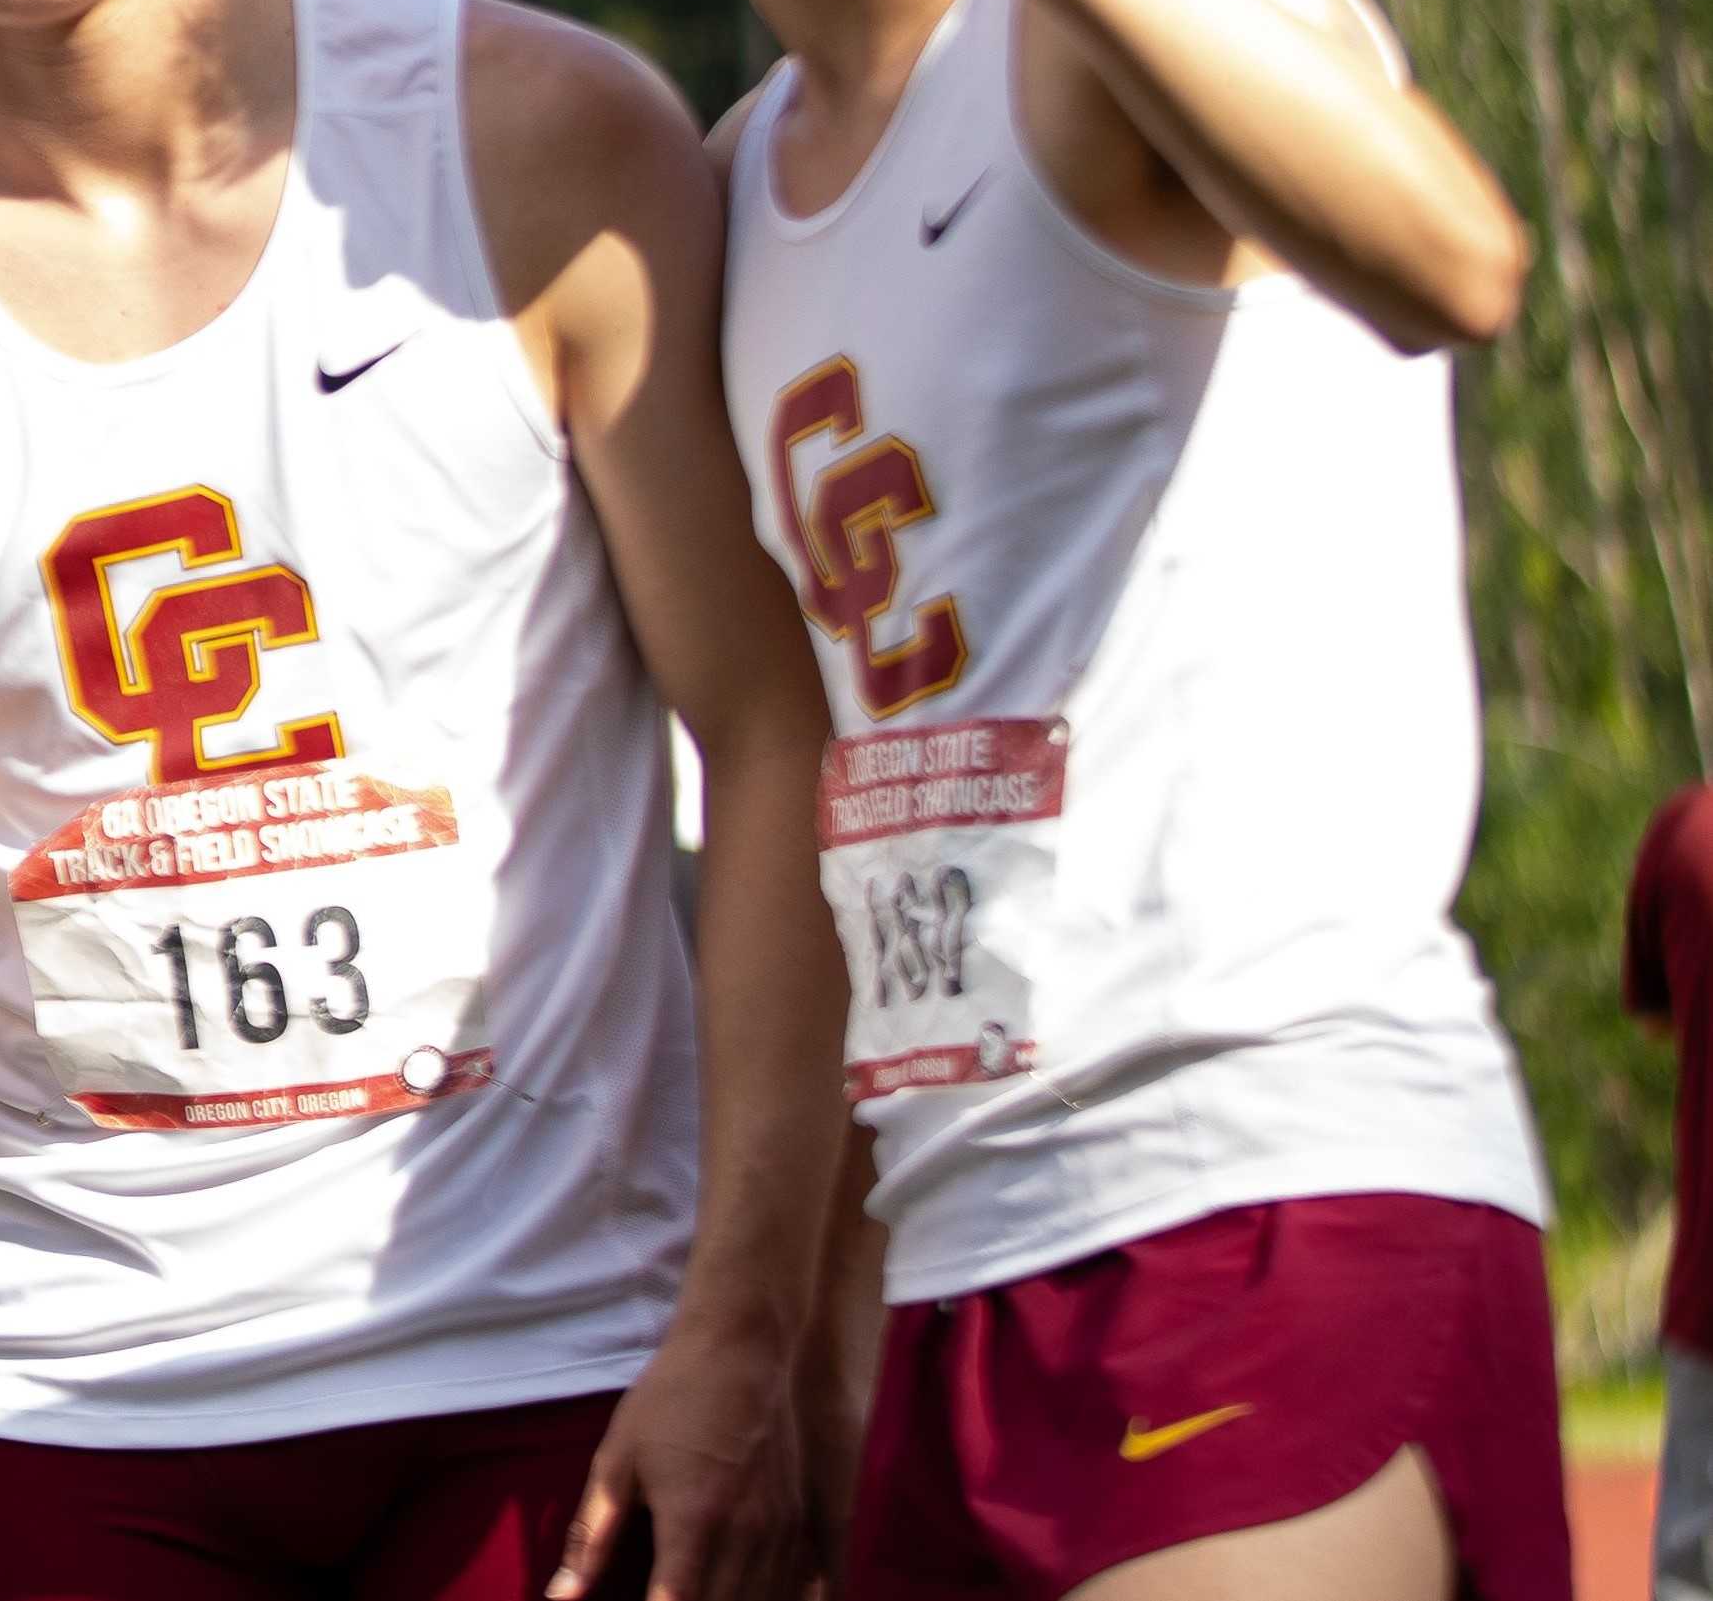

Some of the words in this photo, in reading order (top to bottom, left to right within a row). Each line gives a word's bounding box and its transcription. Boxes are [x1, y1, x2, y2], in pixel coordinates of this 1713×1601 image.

[39, 484, 345, 786] CC
[924, 729, 992, 772] STATE
[145, 783, 261, 835] OREGON
[263, 771, 358, 818] STATE
[48, 843, 147, 885] TRACK
[149, 841, 173, 877] &
[176, 828, 259, 875] FIELD
[150, 905, 371, 1051] 163
[184, 1102, 249, 1122] OREGON
[297, 1088, 367, 1113] OREGON
